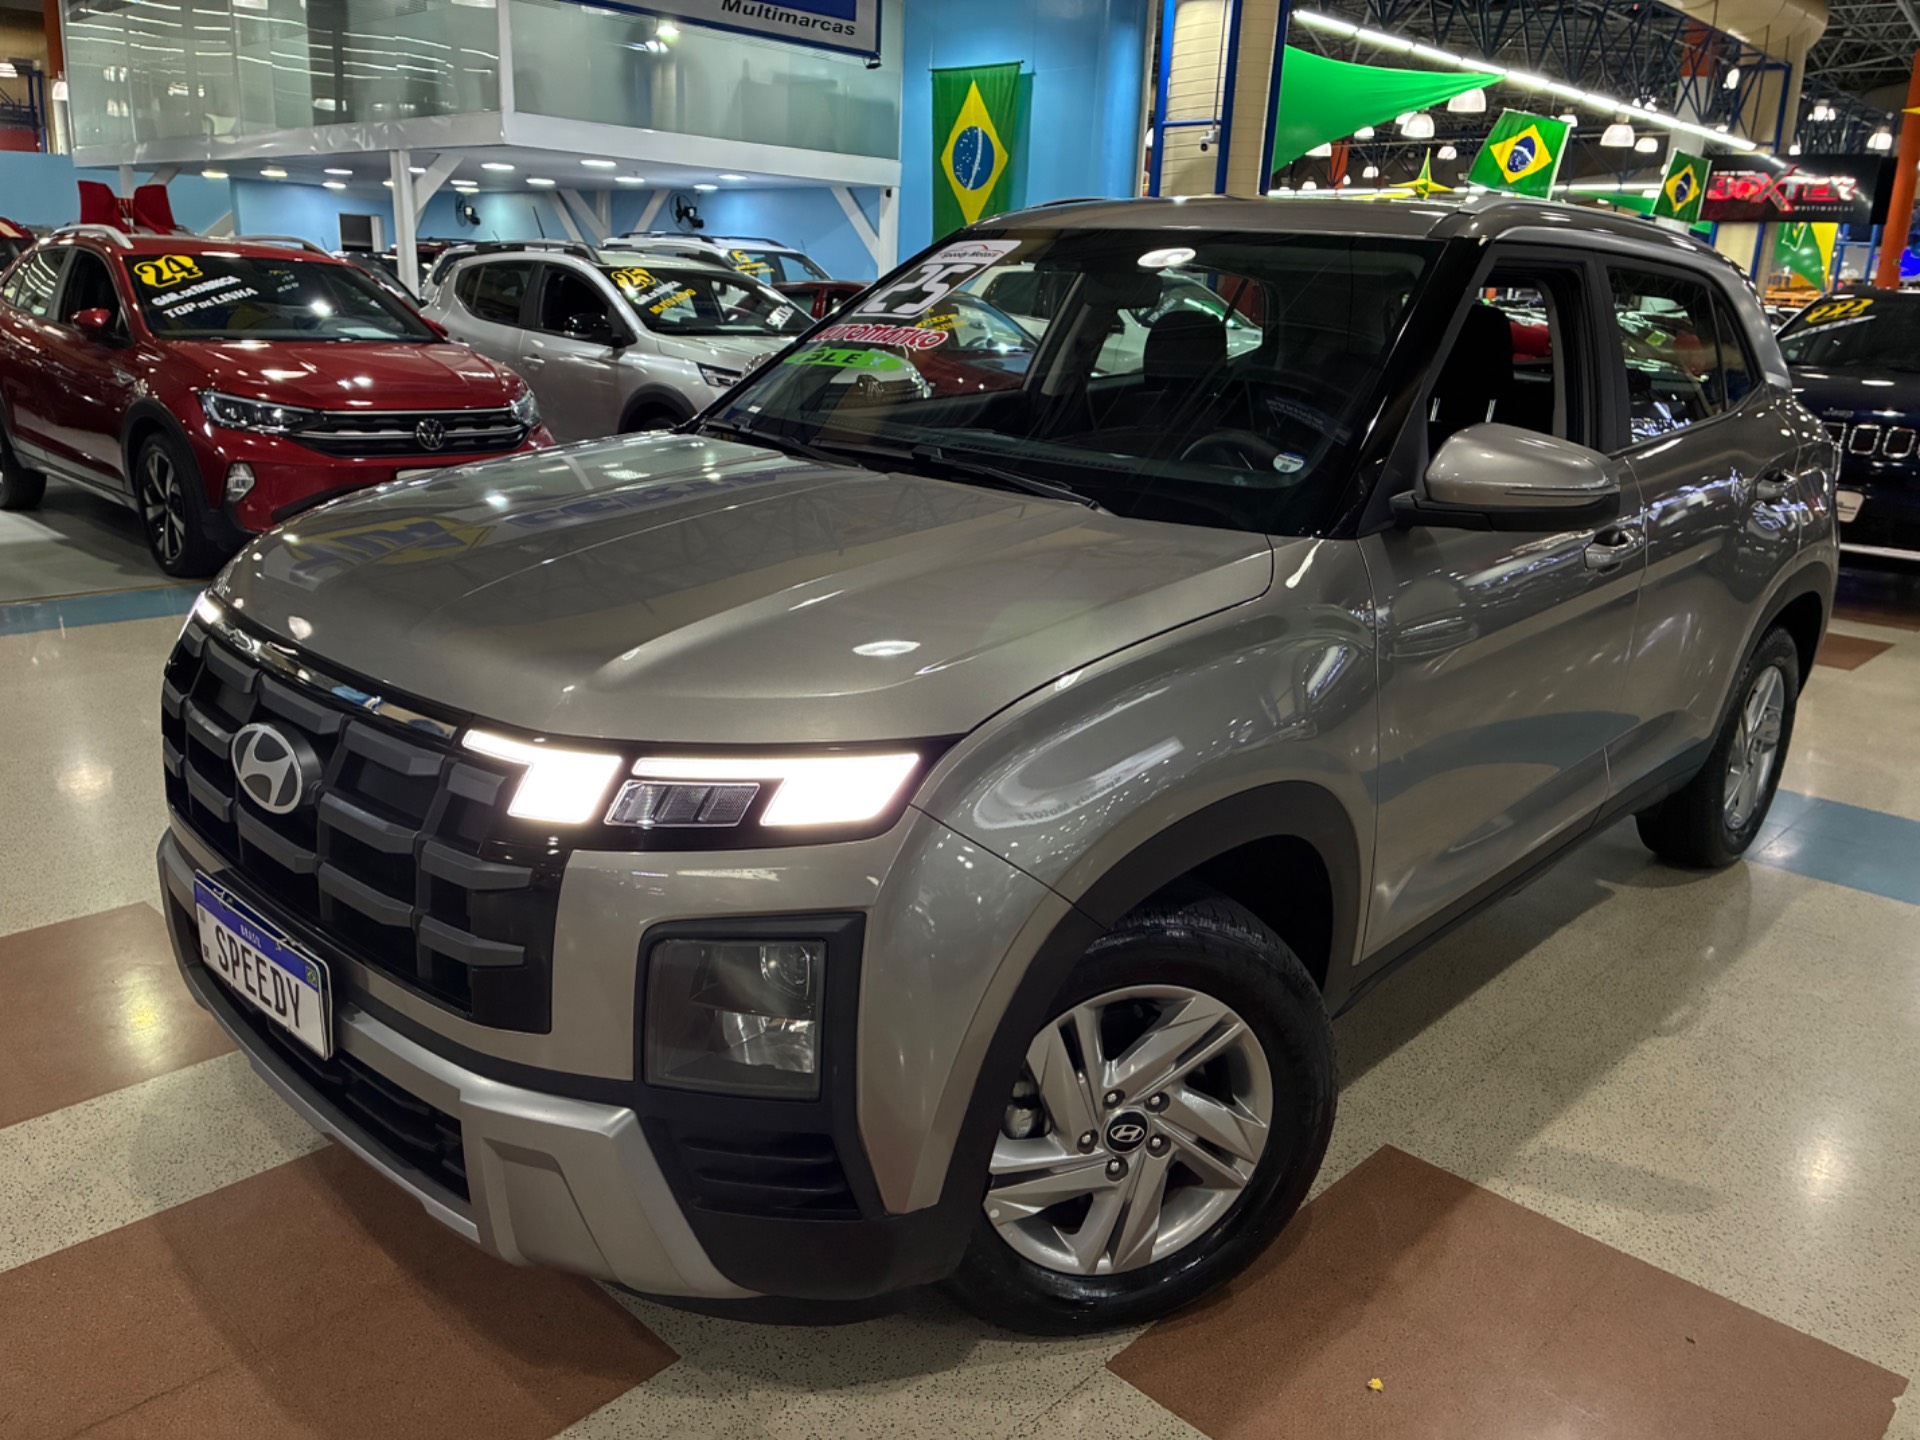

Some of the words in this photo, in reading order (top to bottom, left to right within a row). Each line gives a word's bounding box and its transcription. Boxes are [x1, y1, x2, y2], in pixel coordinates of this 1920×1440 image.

[721, 0, 856, 36] Multimarcas
[1706, 164, 1856, 212] BOXTER
[136, 255, 202, 286] 24
[163, 302, 197, 318] TOP
[212, 287, 259, 305] LINHA
[862, 264, 977, 314] 25
[240, 924, 262, 949] BRASIL
[215, 925, 300, 1028] SPEEDY
